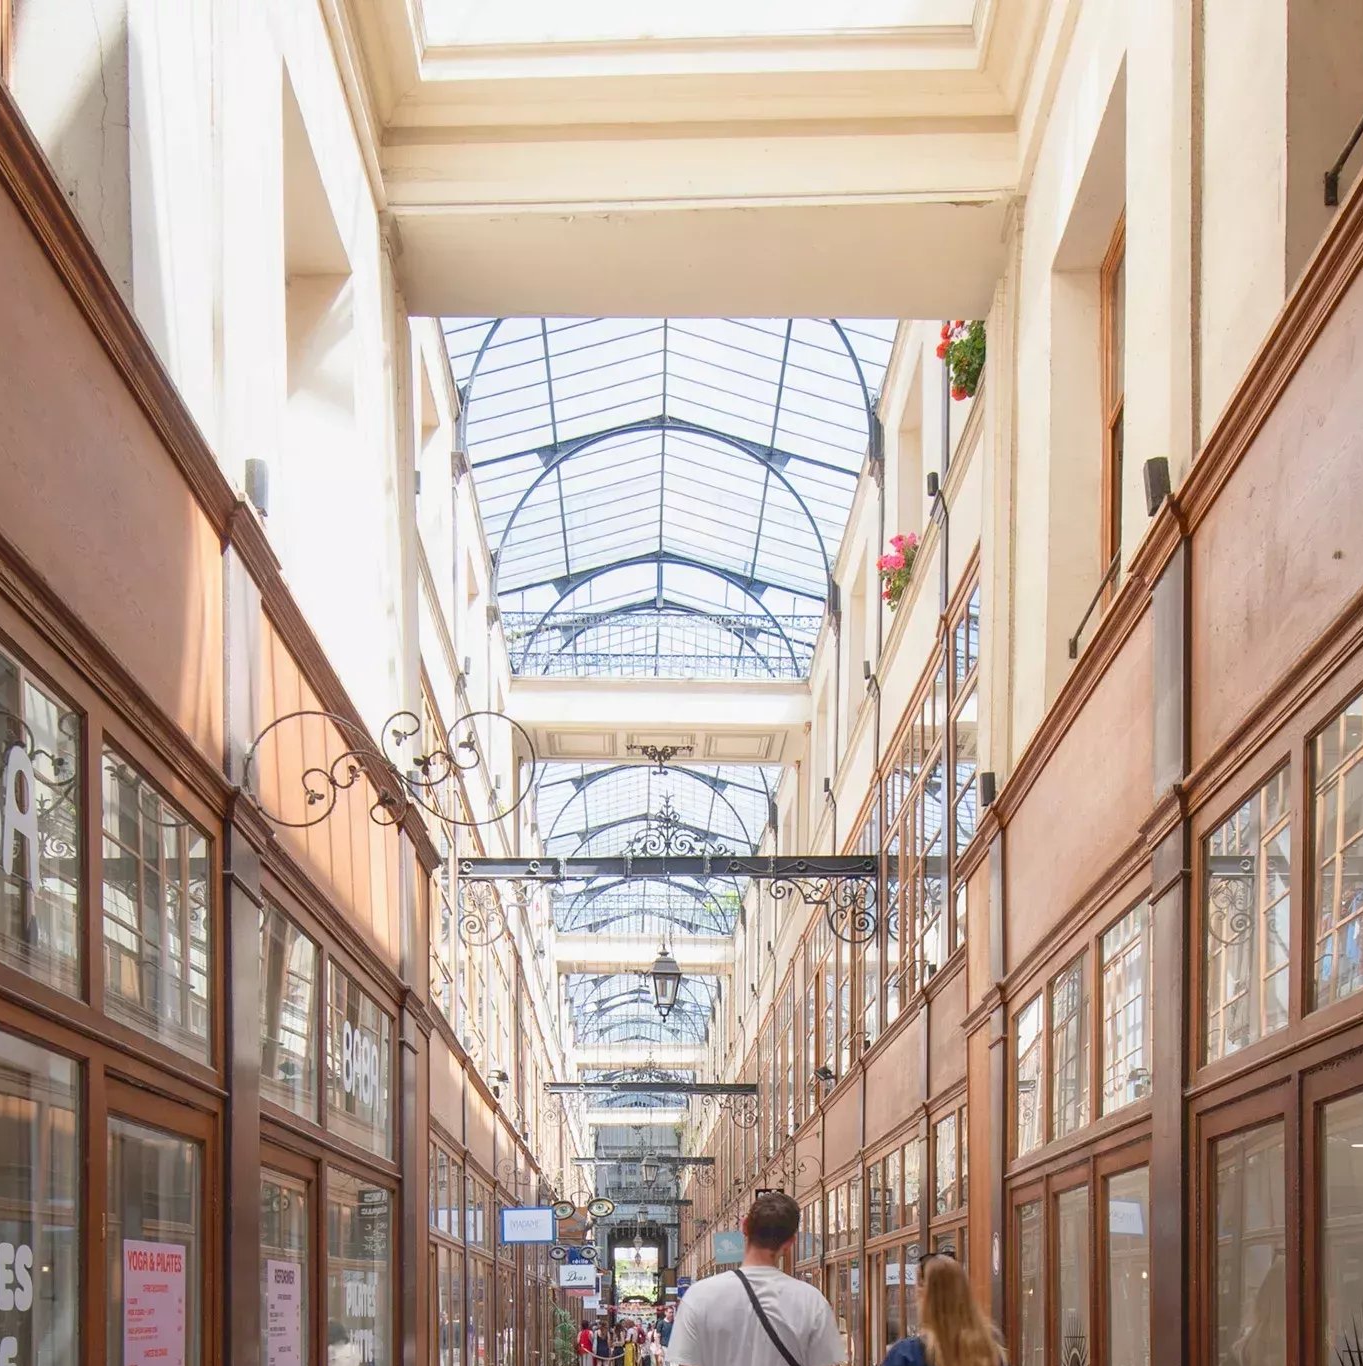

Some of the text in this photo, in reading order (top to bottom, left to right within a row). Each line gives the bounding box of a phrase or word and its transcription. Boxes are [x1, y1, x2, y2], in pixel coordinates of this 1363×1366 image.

[342, 1020, 379, 1112] BABA
[127, 1250, 182, 1273] YOGA & PILATES
